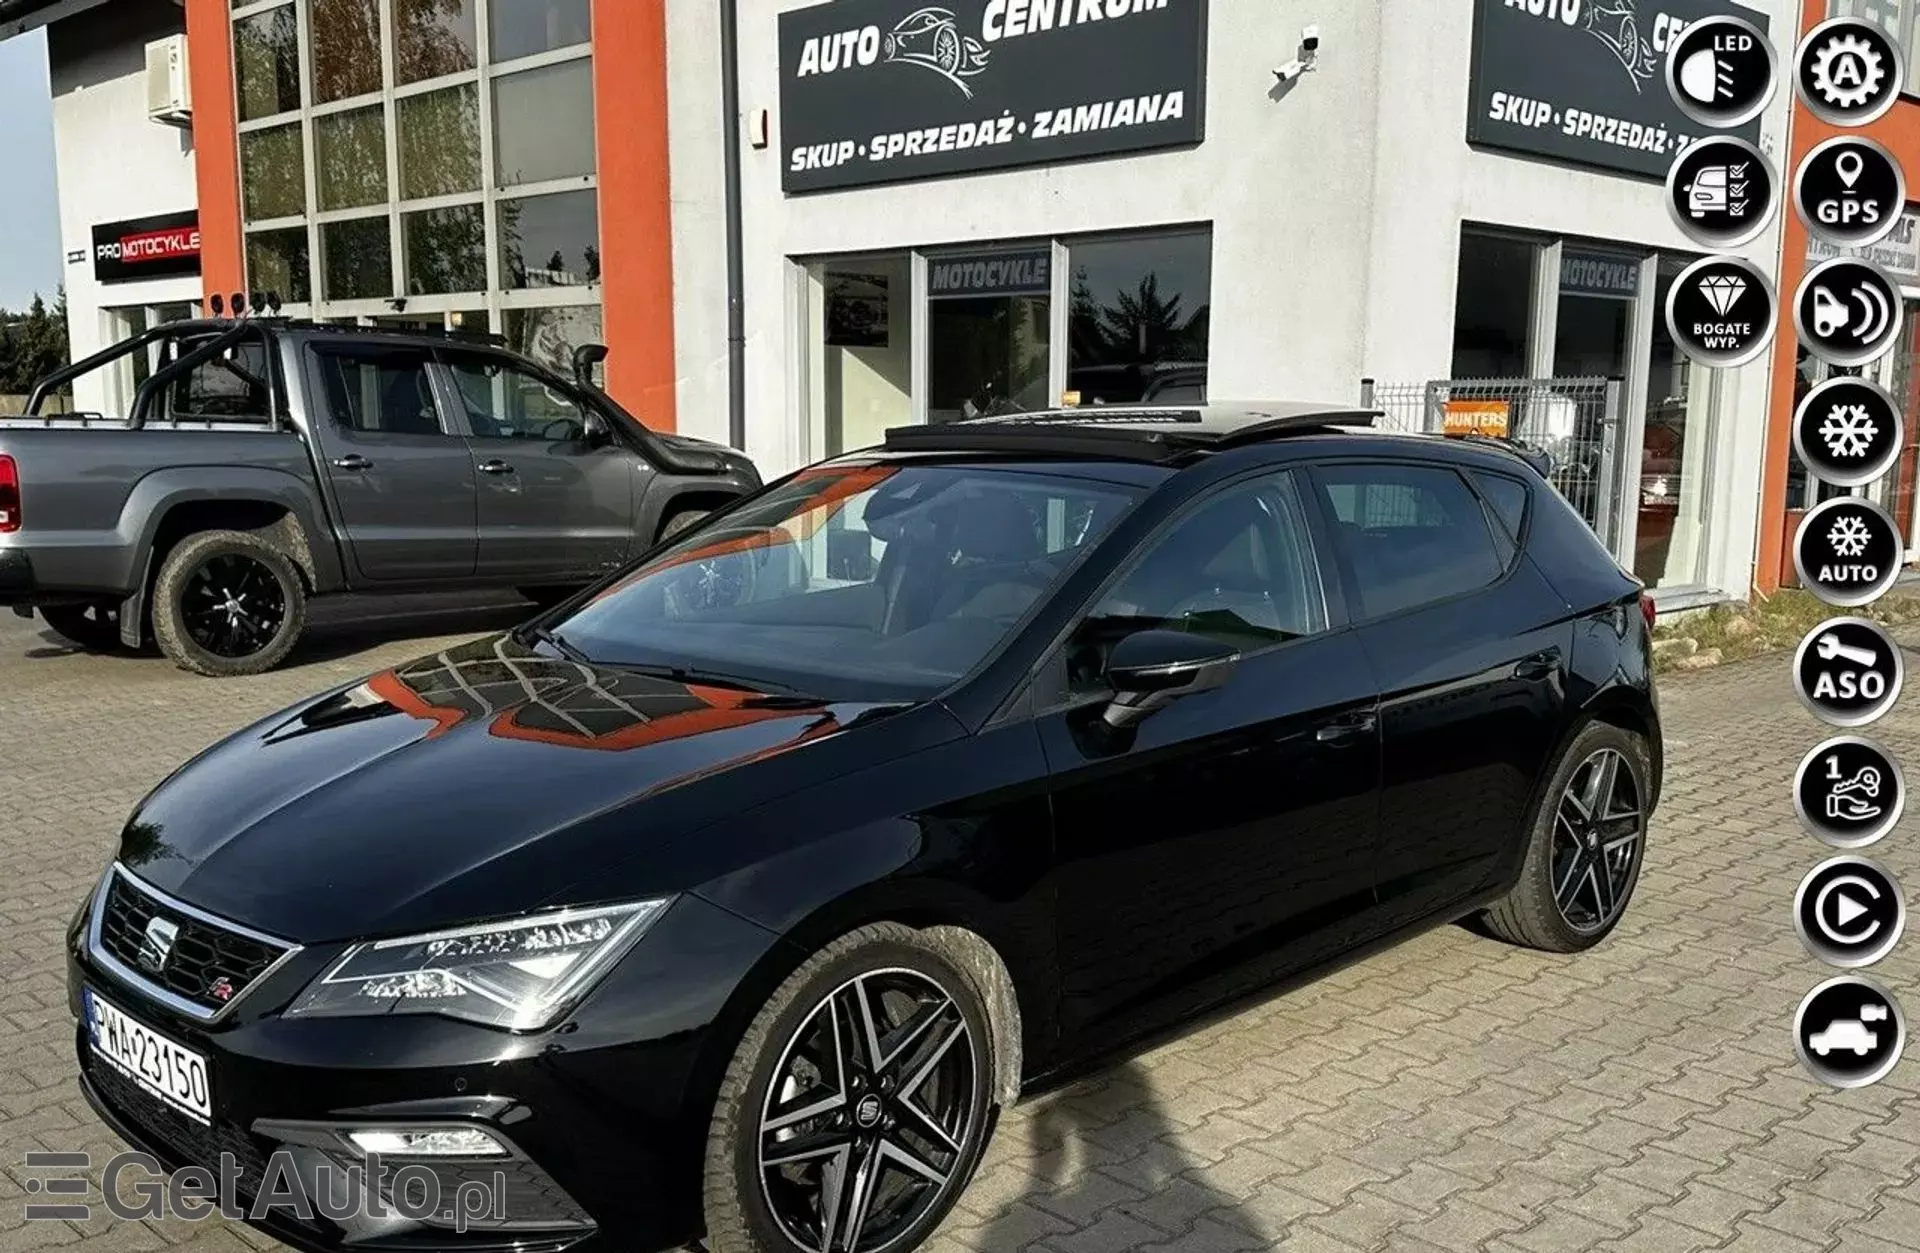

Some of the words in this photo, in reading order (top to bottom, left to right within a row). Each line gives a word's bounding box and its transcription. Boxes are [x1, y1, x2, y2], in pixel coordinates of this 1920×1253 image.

[797, 26, 880, 77] AUTO
[790, 141, 855, 171] SKUP
[869, 109, 1016, 161] SPRZEDAŻ
[1031, 91, 1184, 139] ZAMIANA
[1489, 91, 1552, 128] SKUP
[1562, 108, 1667, 154] SPRZEDAŻ
[932, 258, 1047, 289] MOTOCYKLE
[1444, 411, 1508, 427] HUNTERS
